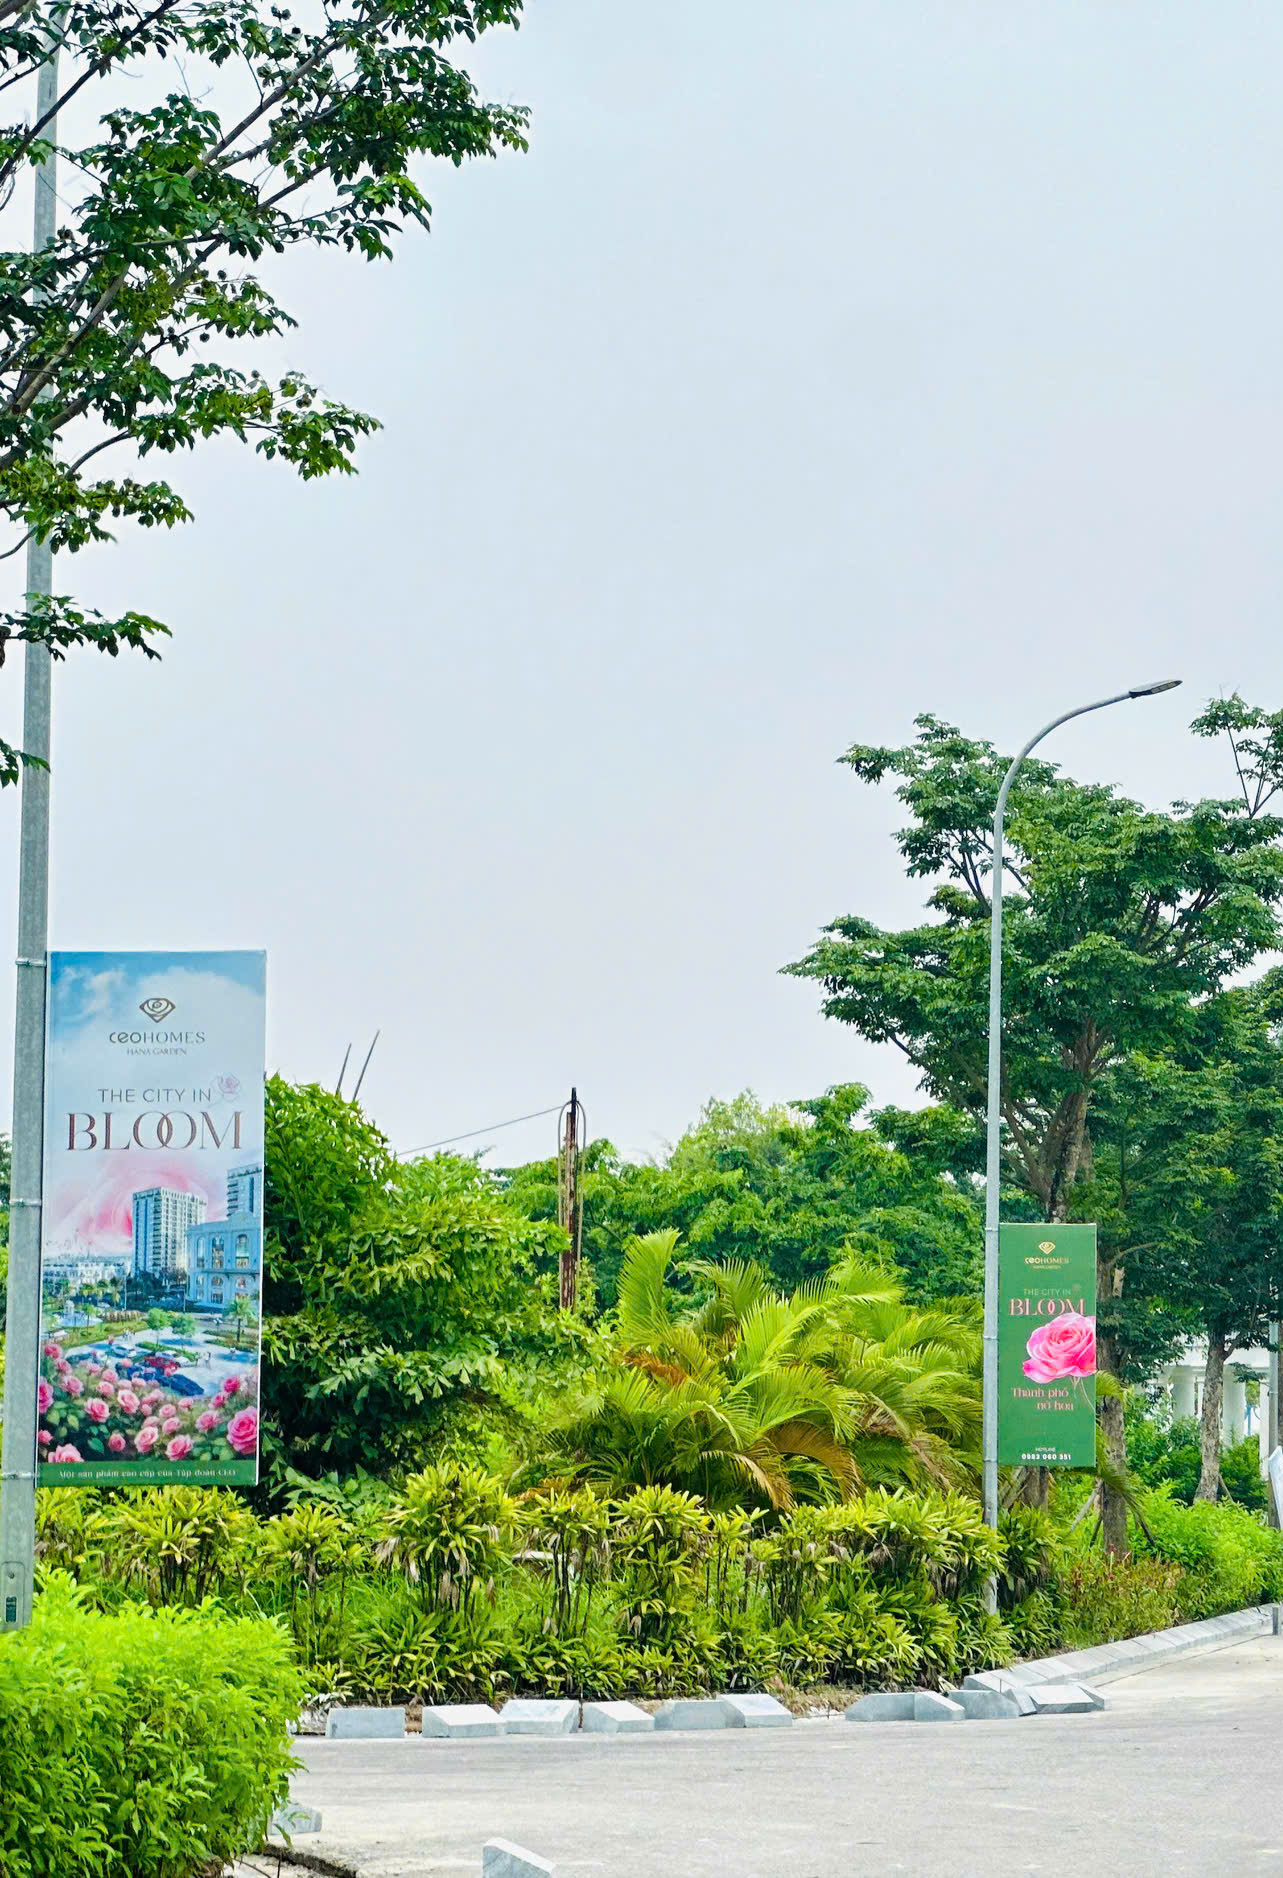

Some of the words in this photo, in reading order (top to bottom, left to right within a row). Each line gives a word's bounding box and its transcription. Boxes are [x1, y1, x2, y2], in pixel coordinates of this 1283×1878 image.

[98, 1088, 136, 1103] THE
[142, 1088, 186, 1103] CITY
[193, 1088, 212, 1103] IN
[66, 1111, 243, 1151] BLOOM
[1024, 1288, 1039, 1296] THE
[1041, 1288, 1060, 1296] CITY
[1062, 1288, 1071, 1296] IN
[1009, 1298, 1085, 1316] BLOOM
